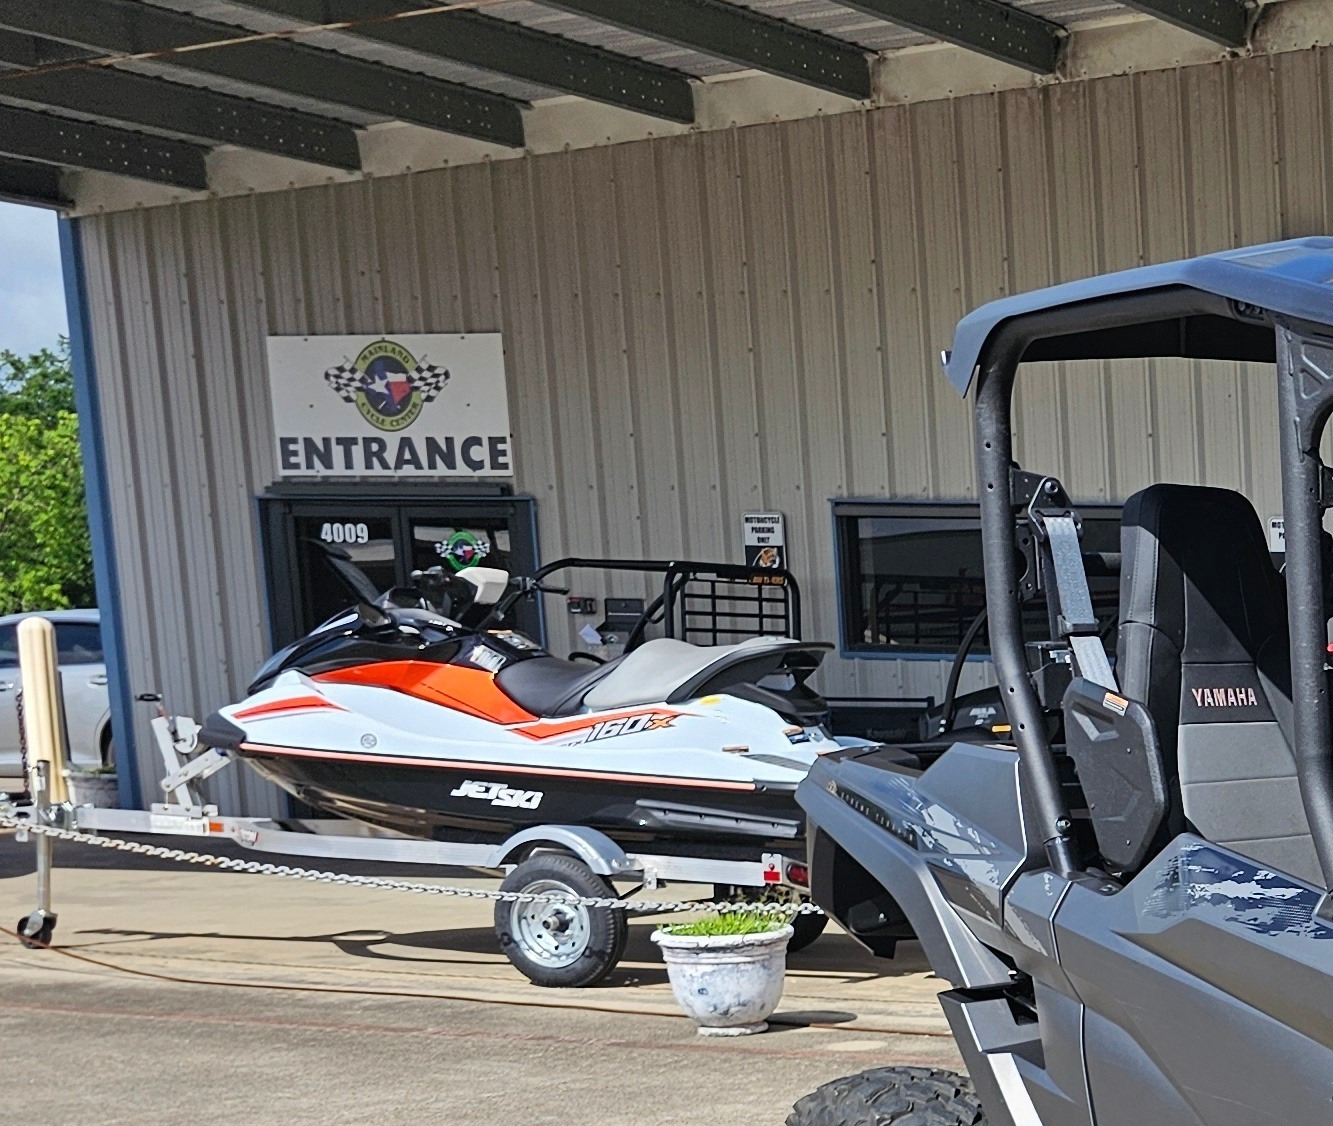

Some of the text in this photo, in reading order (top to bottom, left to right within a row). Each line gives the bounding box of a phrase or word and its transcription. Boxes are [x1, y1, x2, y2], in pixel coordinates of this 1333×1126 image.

[361, 344, 410, 365] MAINLAND
[361, 401, 420, 428] CYCLE CENTER
[279, 436, 510, 472] ENTRANCE
[320, 523, 369, 544] 4009
[1191, 687, 1258, 707] YAMAHA
